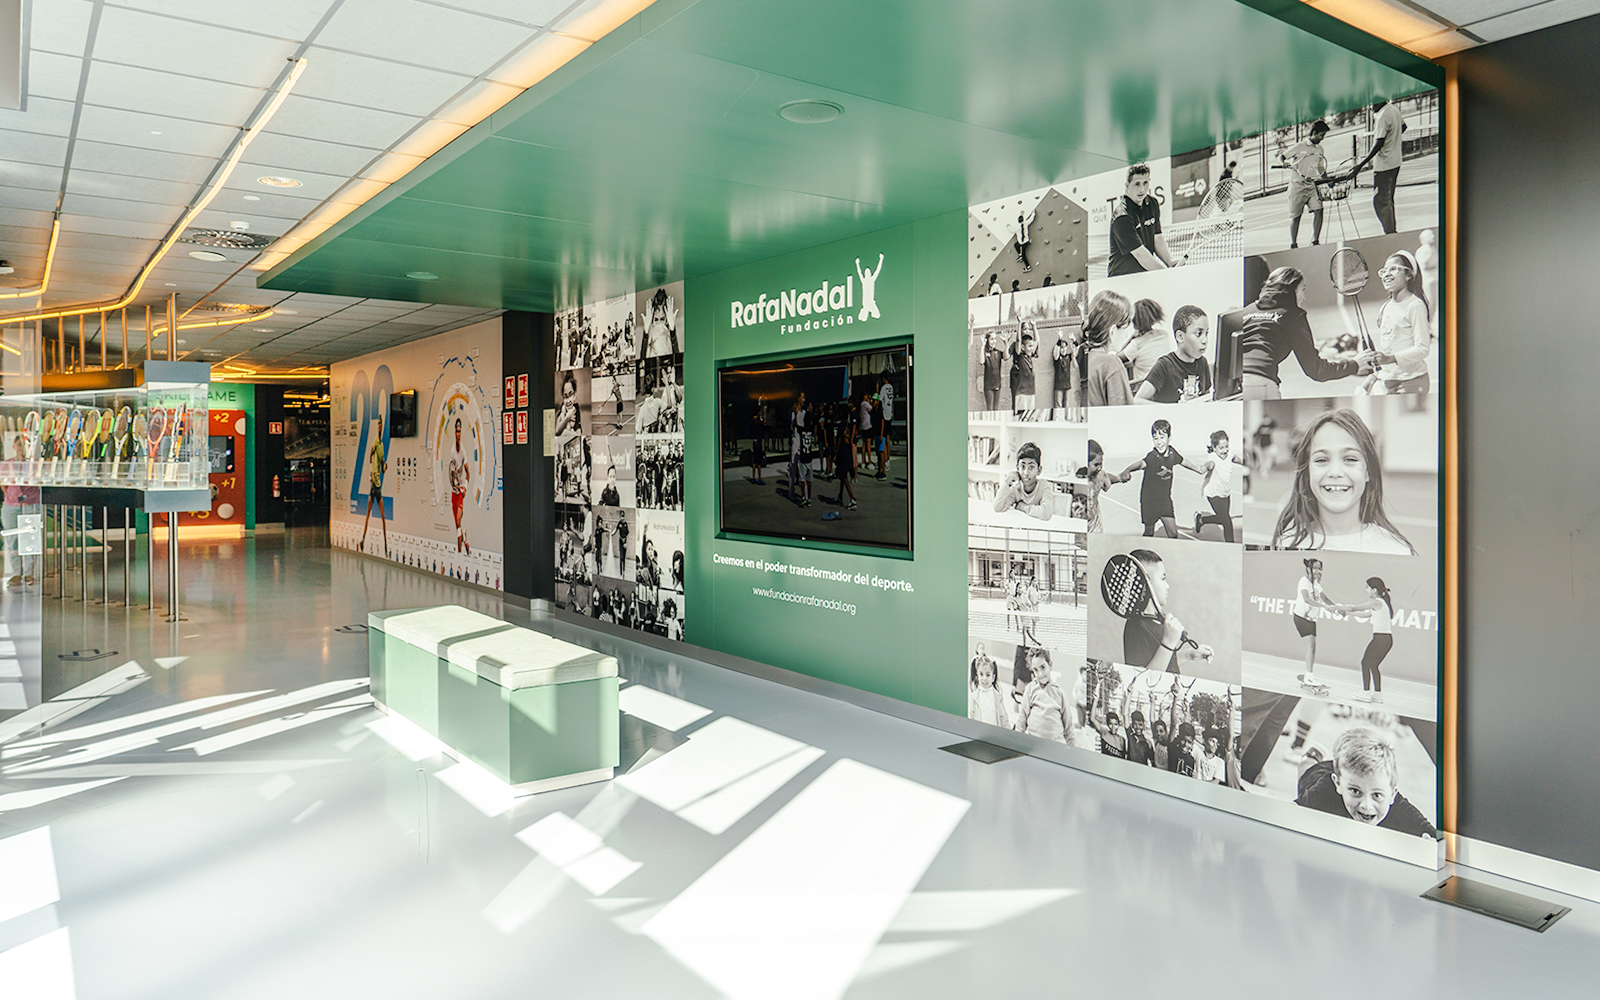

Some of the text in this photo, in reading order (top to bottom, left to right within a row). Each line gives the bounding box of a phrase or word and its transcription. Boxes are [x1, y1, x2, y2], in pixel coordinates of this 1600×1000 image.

[730, 275, 854, 329] RafaNadal
[780, 313, 854, 335] Fundación
[213, 412, 230, 423] +2
[713, 553, 914, 593] Creemos en el poder transformador del deporte.
[752, 586, 857, 615] www.fundacionrafanadal.org
